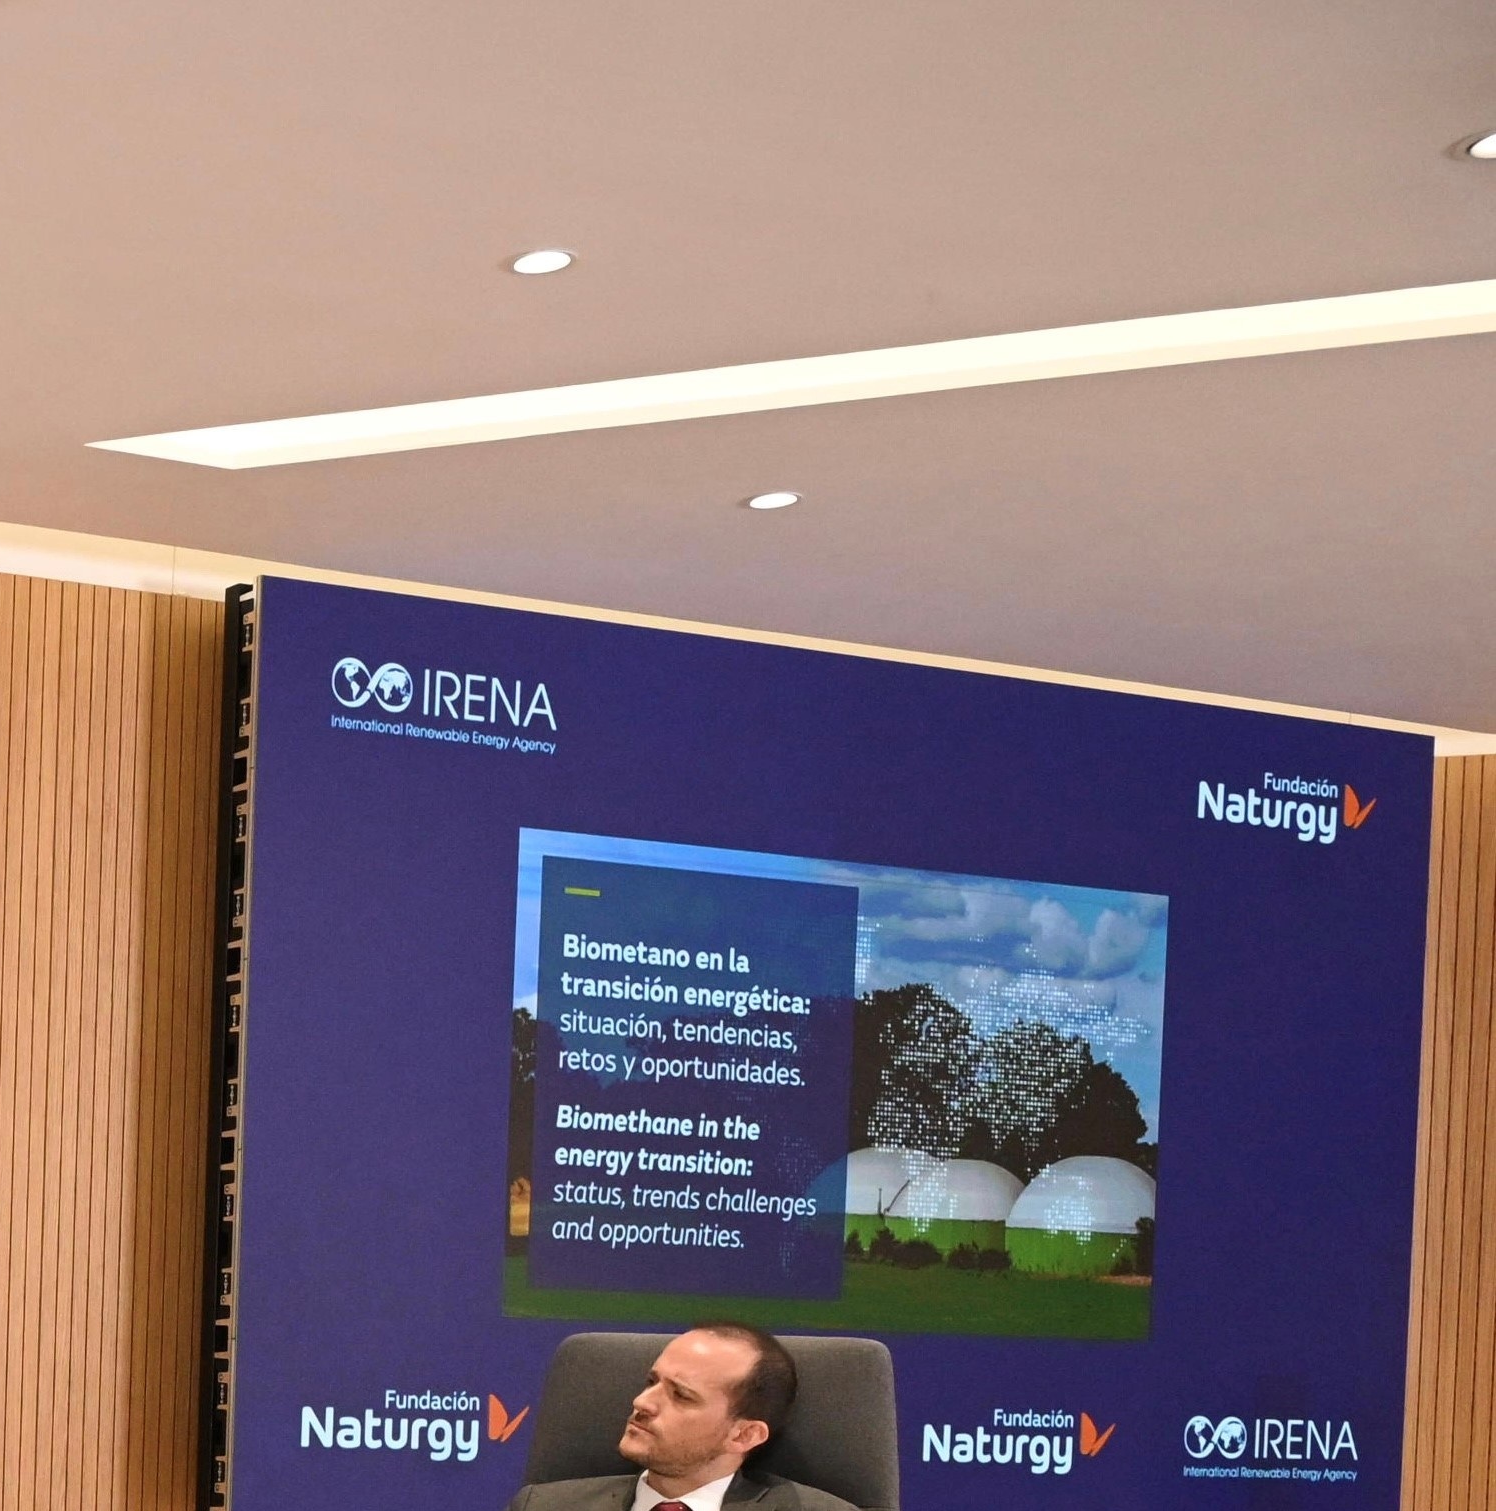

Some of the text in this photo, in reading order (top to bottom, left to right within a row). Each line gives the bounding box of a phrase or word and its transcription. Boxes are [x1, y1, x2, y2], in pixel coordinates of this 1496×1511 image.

[422, 668, 557, 731] IRENA
[331, 715, 557, 755] International Renewable Energy Agency
[1264, 772, 1339, 798] Fundación
[1197, 780, 1338, 844] Naturgy
[562, 932, 750, 974] Biometano en la
[561, 970, 811, 1018] transición energética:
[559, 1008, 798, 1053] situación, tendencias,
[558, 1047, 806, 1087] retos y oportunidades.
[556, 1104, 761, 1141] Biomethane in the
[554, 1146, 753, 1177] energy transition:
[553, 1181, 817, 1222] status, trends challenges
[552, 1216, 745, 1250] and opportunities.
[385, 1390, 480, 1411] Fundación
[993, 1408, 1074, 1428] Fundación
[300, 1406, 480, 1462] Naturgy
[922, 1424, 1074, 1474] Naturgy
[1254, 1418, 1358, 1461] IRENA
[1183, 1465, 1357, 1482] International Renewable Energy Agency
